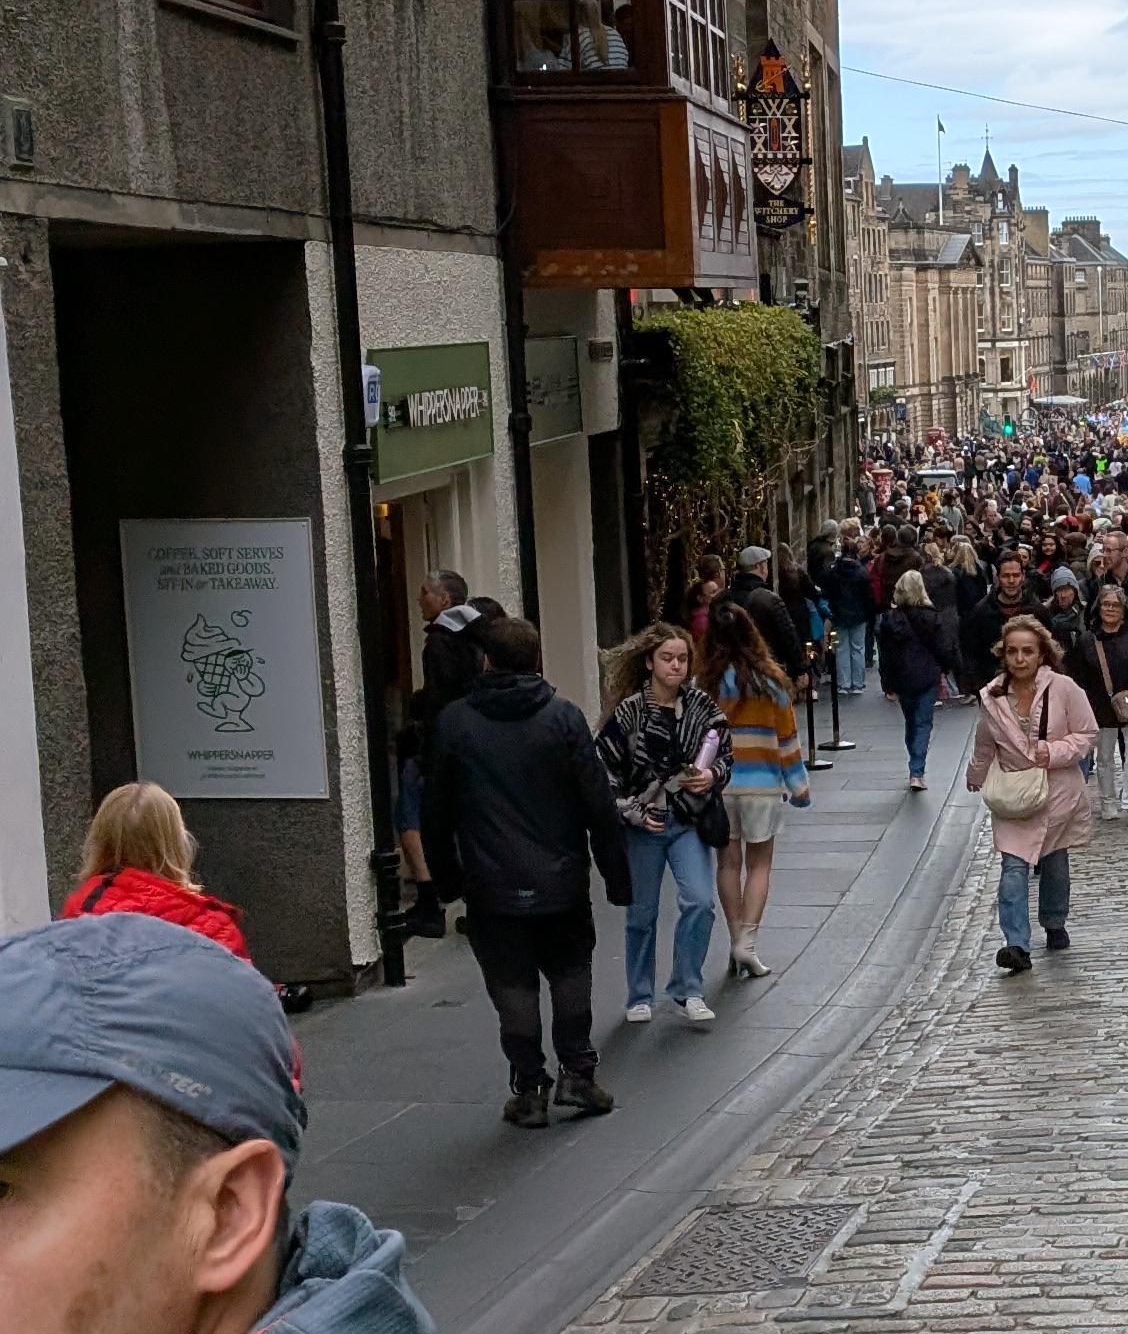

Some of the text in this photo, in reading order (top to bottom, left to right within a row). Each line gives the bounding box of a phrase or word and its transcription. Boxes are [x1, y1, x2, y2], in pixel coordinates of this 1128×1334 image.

[768, 199, 785, 207] THE
[754, 207, 799, 215] WITCHERY
[765, 215, 788, 224] SHOP
[407, 387, 480, 427] WHIPPERSNAPPER
[202, 546, 235, 560] SOFT
[237, 546, 284, 560] SERVES
[184, 562, 225, 576] BAKED
[187, 749, 275, 761] WHIPPERSNAPPER
